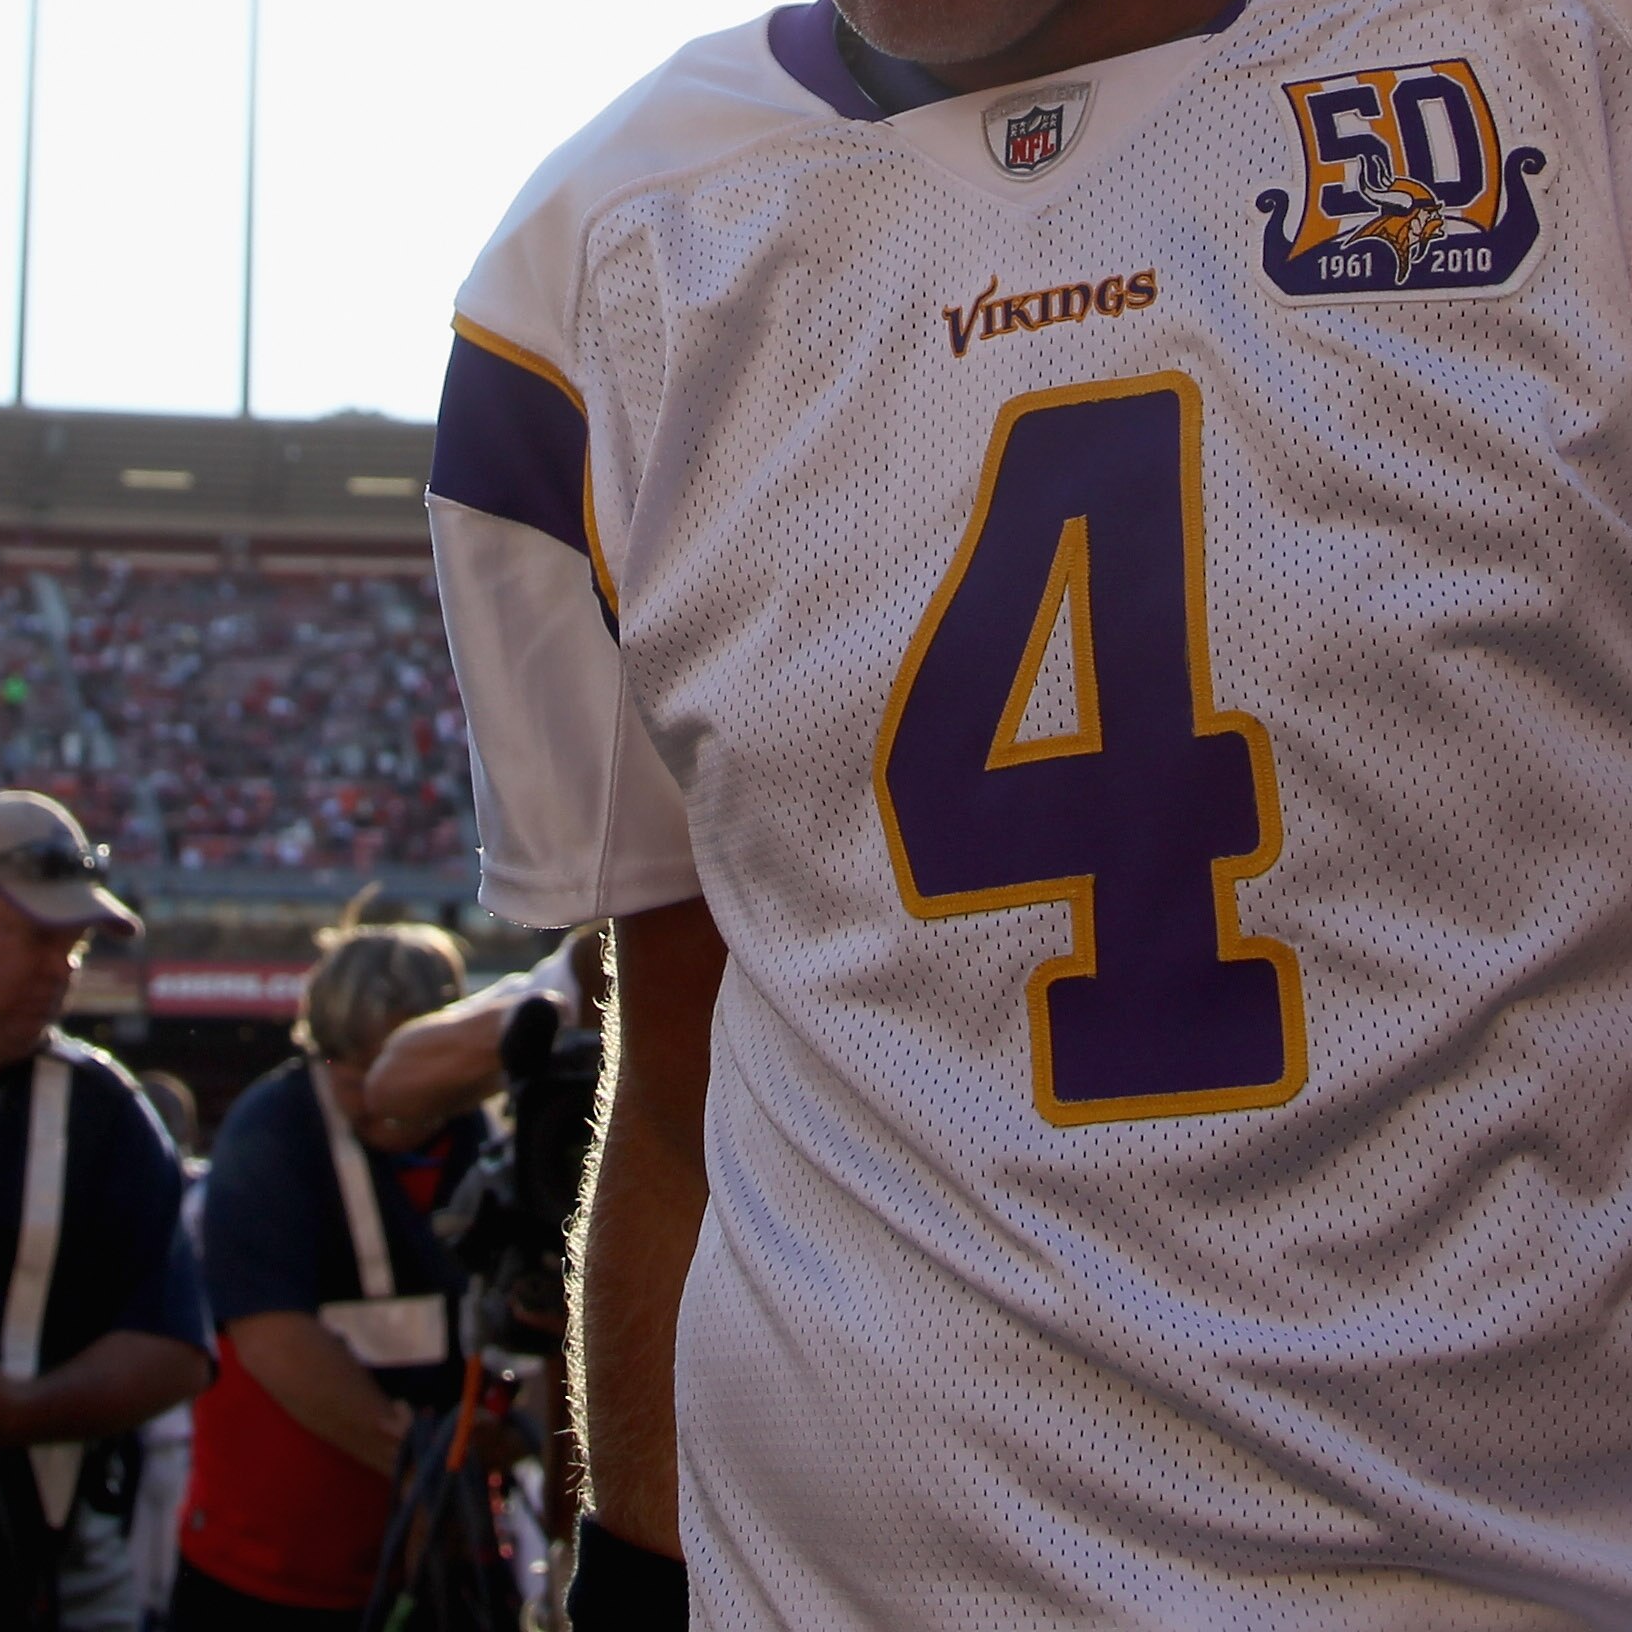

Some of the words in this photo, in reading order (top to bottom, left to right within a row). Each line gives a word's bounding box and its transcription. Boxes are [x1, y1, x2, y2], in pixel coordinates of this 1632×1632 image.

[1010, 130, 1056, 165] NFL
[1306, 73, 1486, 218] 50
[1318, 253, 1374, 280] 1961
[1430, 247, 1493, 273] 2010
[873, 369, 1309, 1127] 4
